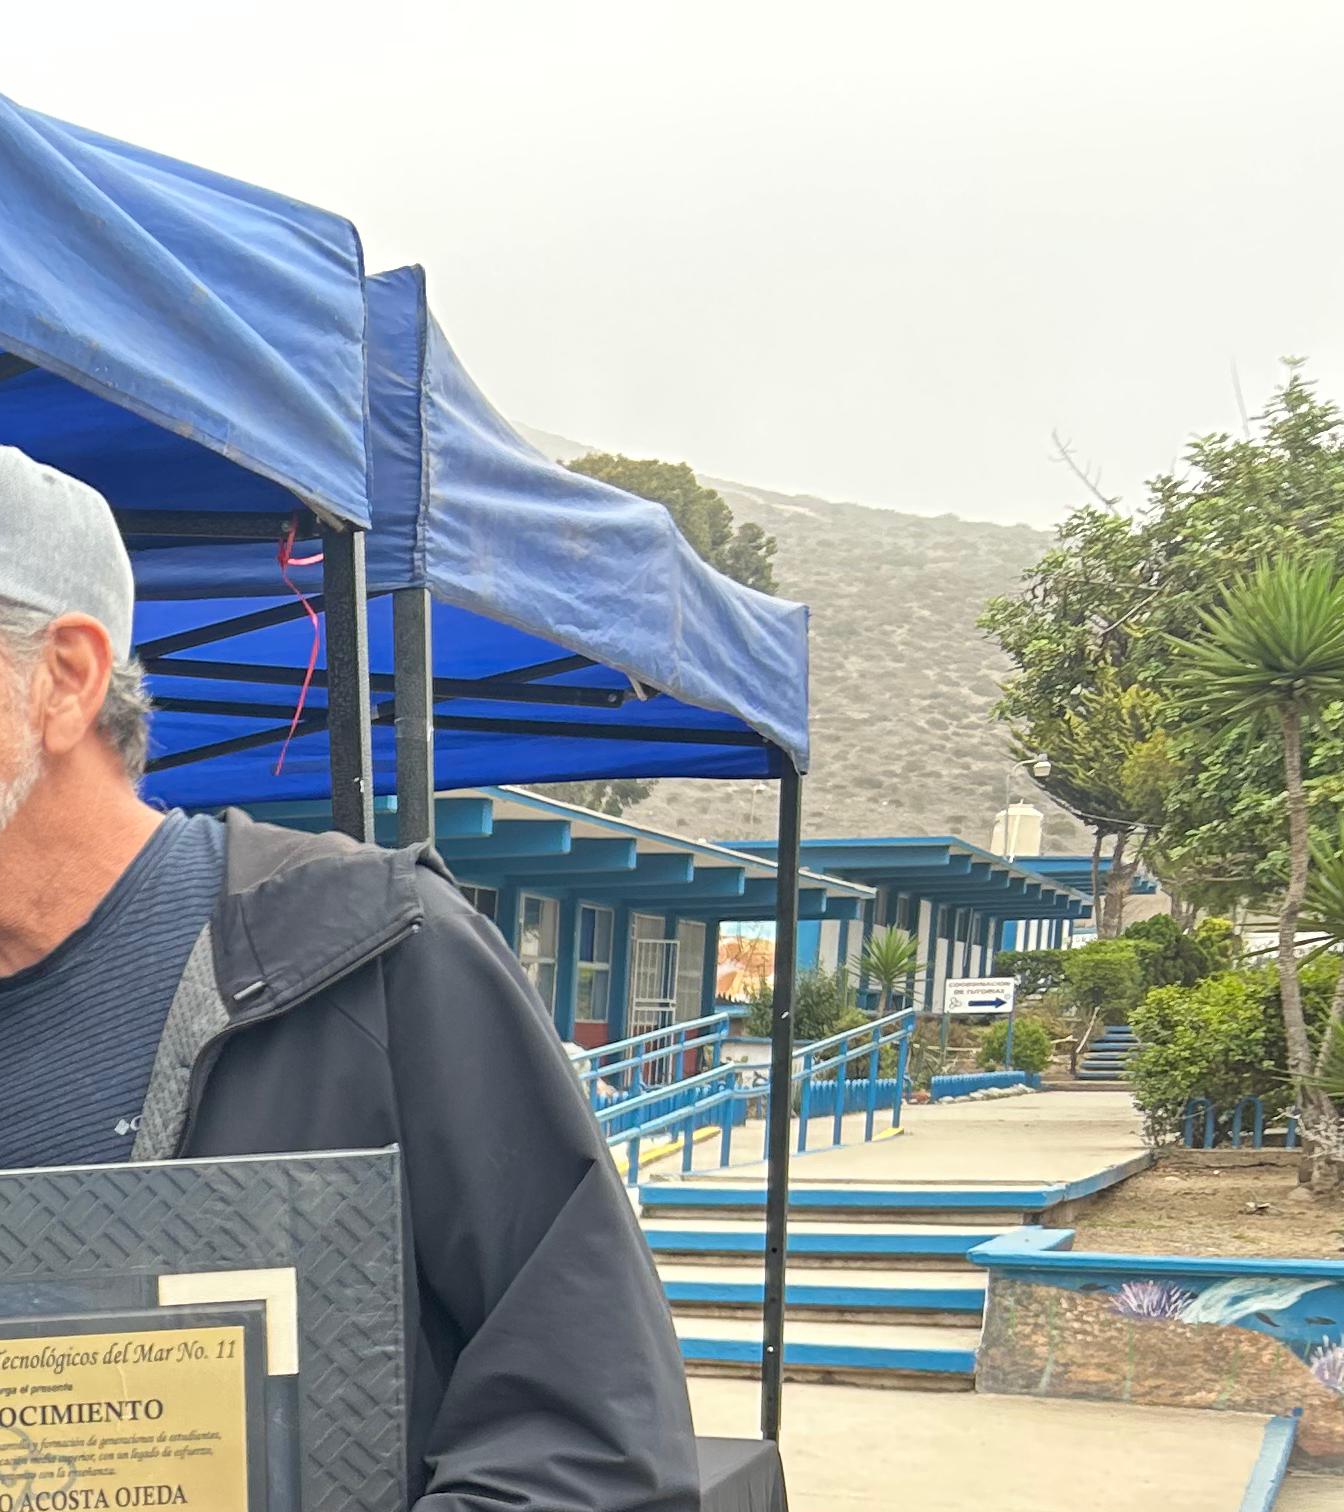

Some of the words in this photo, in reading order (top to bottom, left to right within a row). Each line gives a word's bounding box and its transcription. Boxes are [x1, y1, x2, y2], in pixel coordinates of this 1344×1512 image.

[102, 1342, 132, 1364] del
[132, 1342, 174, 1364] Mar
[175, 1340, 208, 1362] No.
[215, 1339, 236, 1359] 11
[19, 1384, 28, 1394] el
[30, 1383, 73, 1396] presente
[86, 1434, 97, 1446] de
[156, 1431, 167, 1443] de
[162, 1446, 172, 1457] de
[19, 1488, 110, 1512] ACOSTA
[115, 1484, 189, 1507] OJEDA
